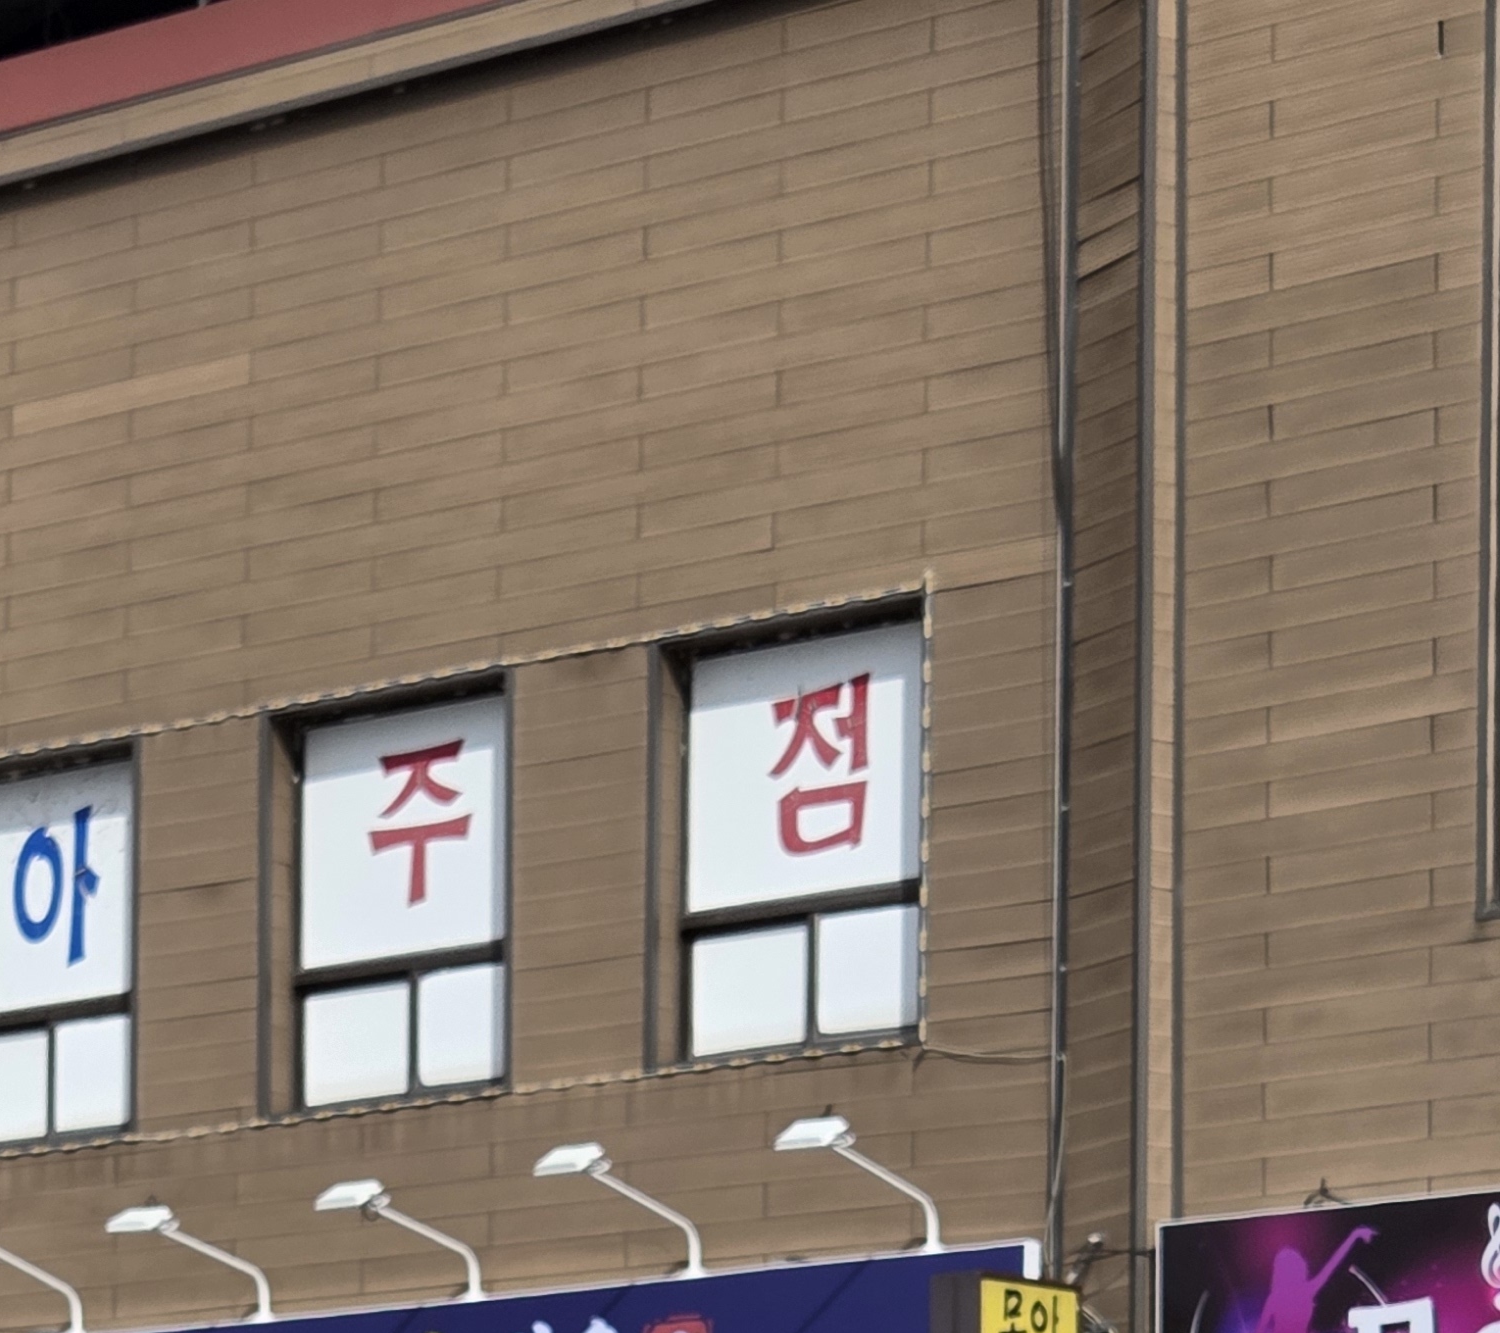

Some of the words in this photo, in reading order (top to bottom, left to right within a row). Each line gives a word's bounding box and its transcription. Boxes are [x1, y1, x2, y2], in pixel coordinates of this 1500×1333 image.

[13, 805, 101, 967] 아
[368, 739, 473, 906] 주
[769, 673, 872, 857] 점
